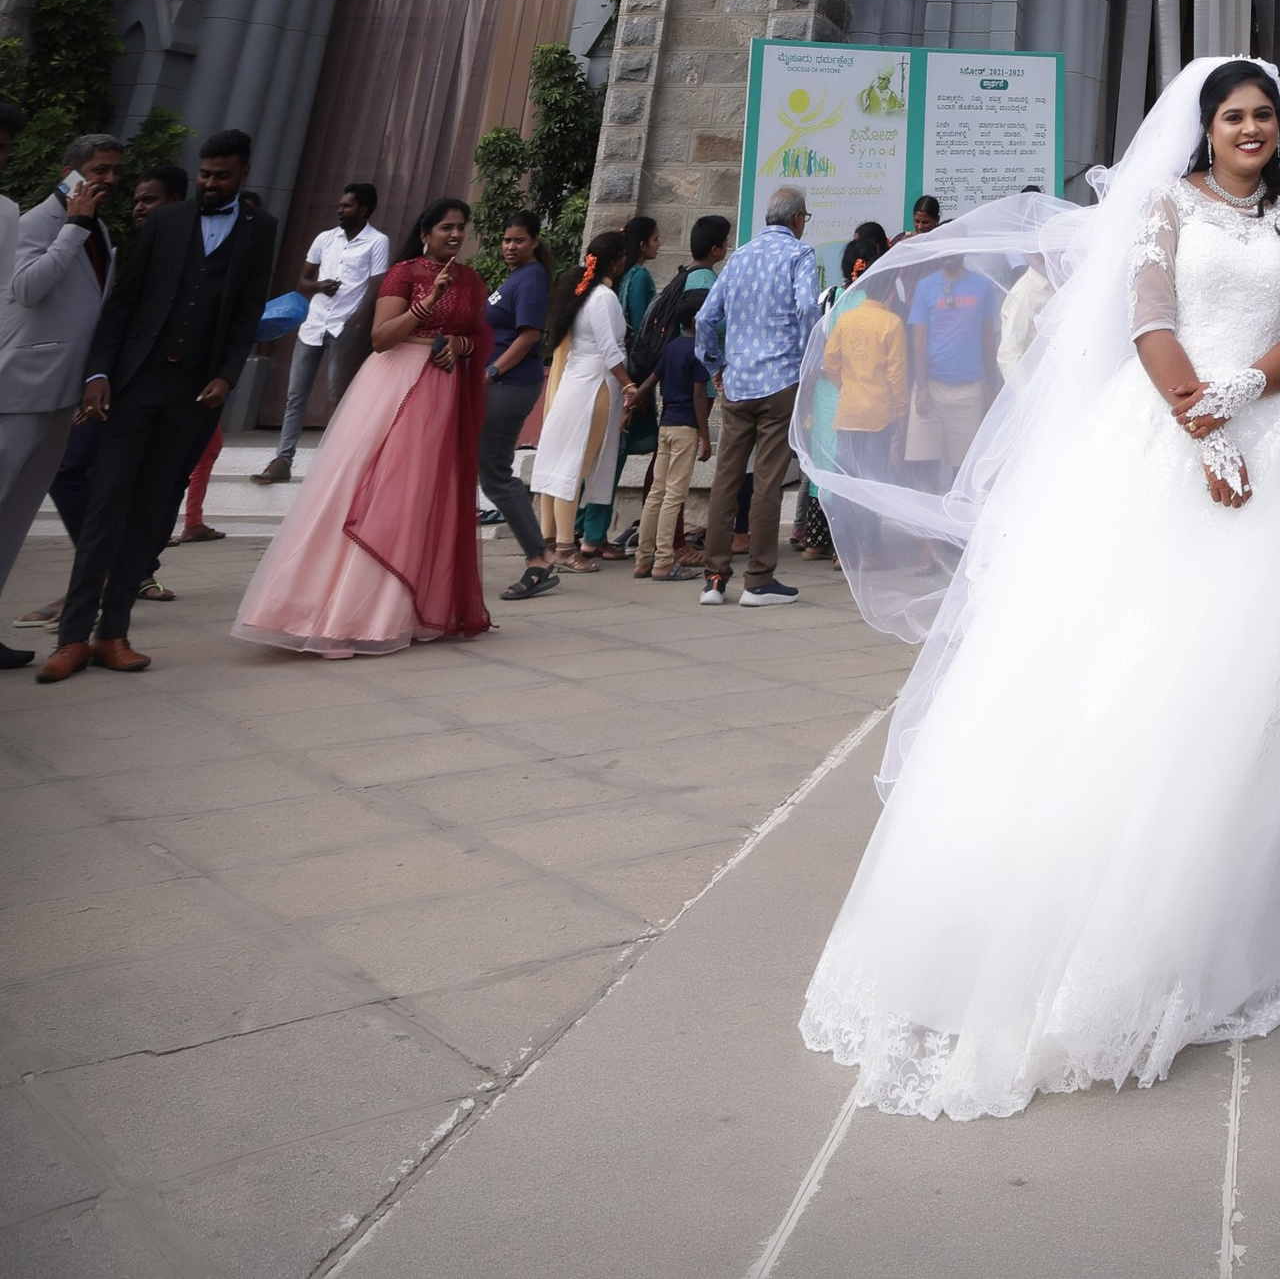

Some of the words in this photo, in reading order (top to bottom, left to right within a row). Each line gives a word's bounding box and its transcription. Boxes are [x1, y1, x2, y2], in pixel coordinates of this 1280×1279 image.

[778, 53, 812, 65] ಮೈಸೂರು
[850, 126, 898, 141] ಸಿನೋಡ್
[849, 144, 896, 159] Synod
